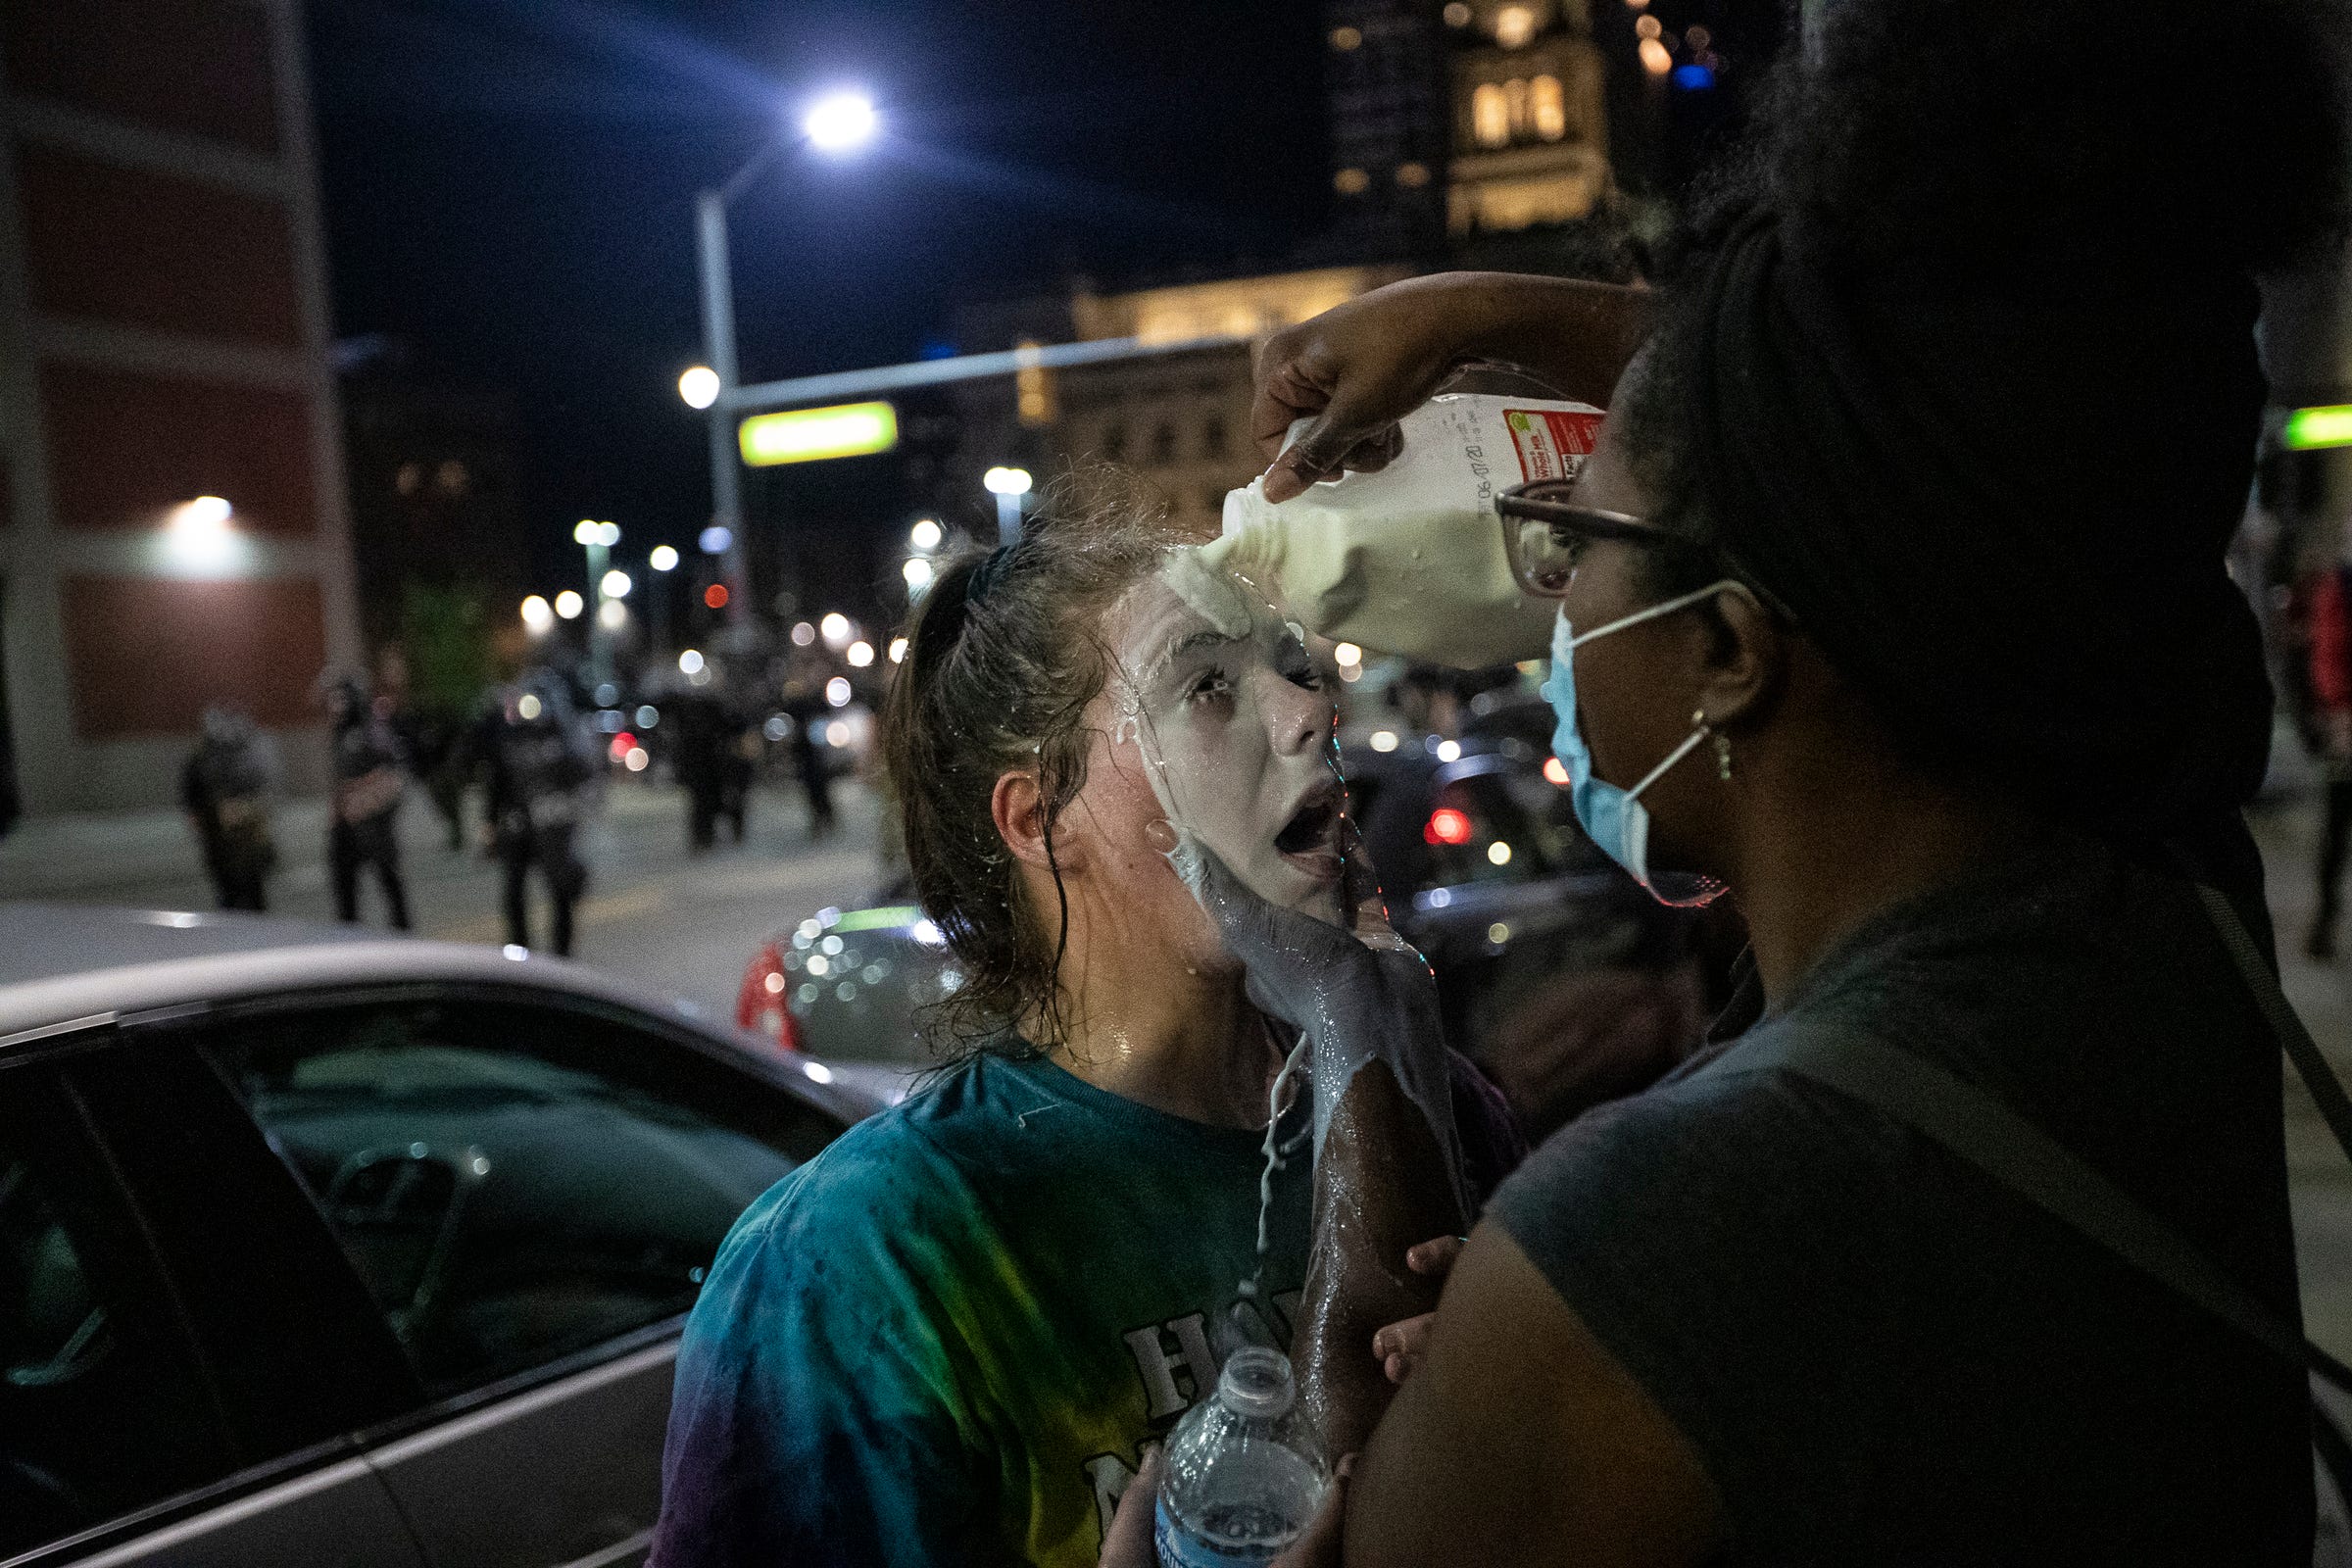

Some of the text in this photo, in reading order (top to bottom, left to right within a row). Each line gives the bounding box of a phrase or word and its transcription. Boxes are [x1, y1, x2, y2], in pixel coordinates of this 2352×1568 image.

[1530, 435, 1542, 450] Milk
[1465, 445, 1491, 499] 06/07/20
[1537, 451, 1548, 479] Whole
[1565, 455, 1574, 474] Facts
